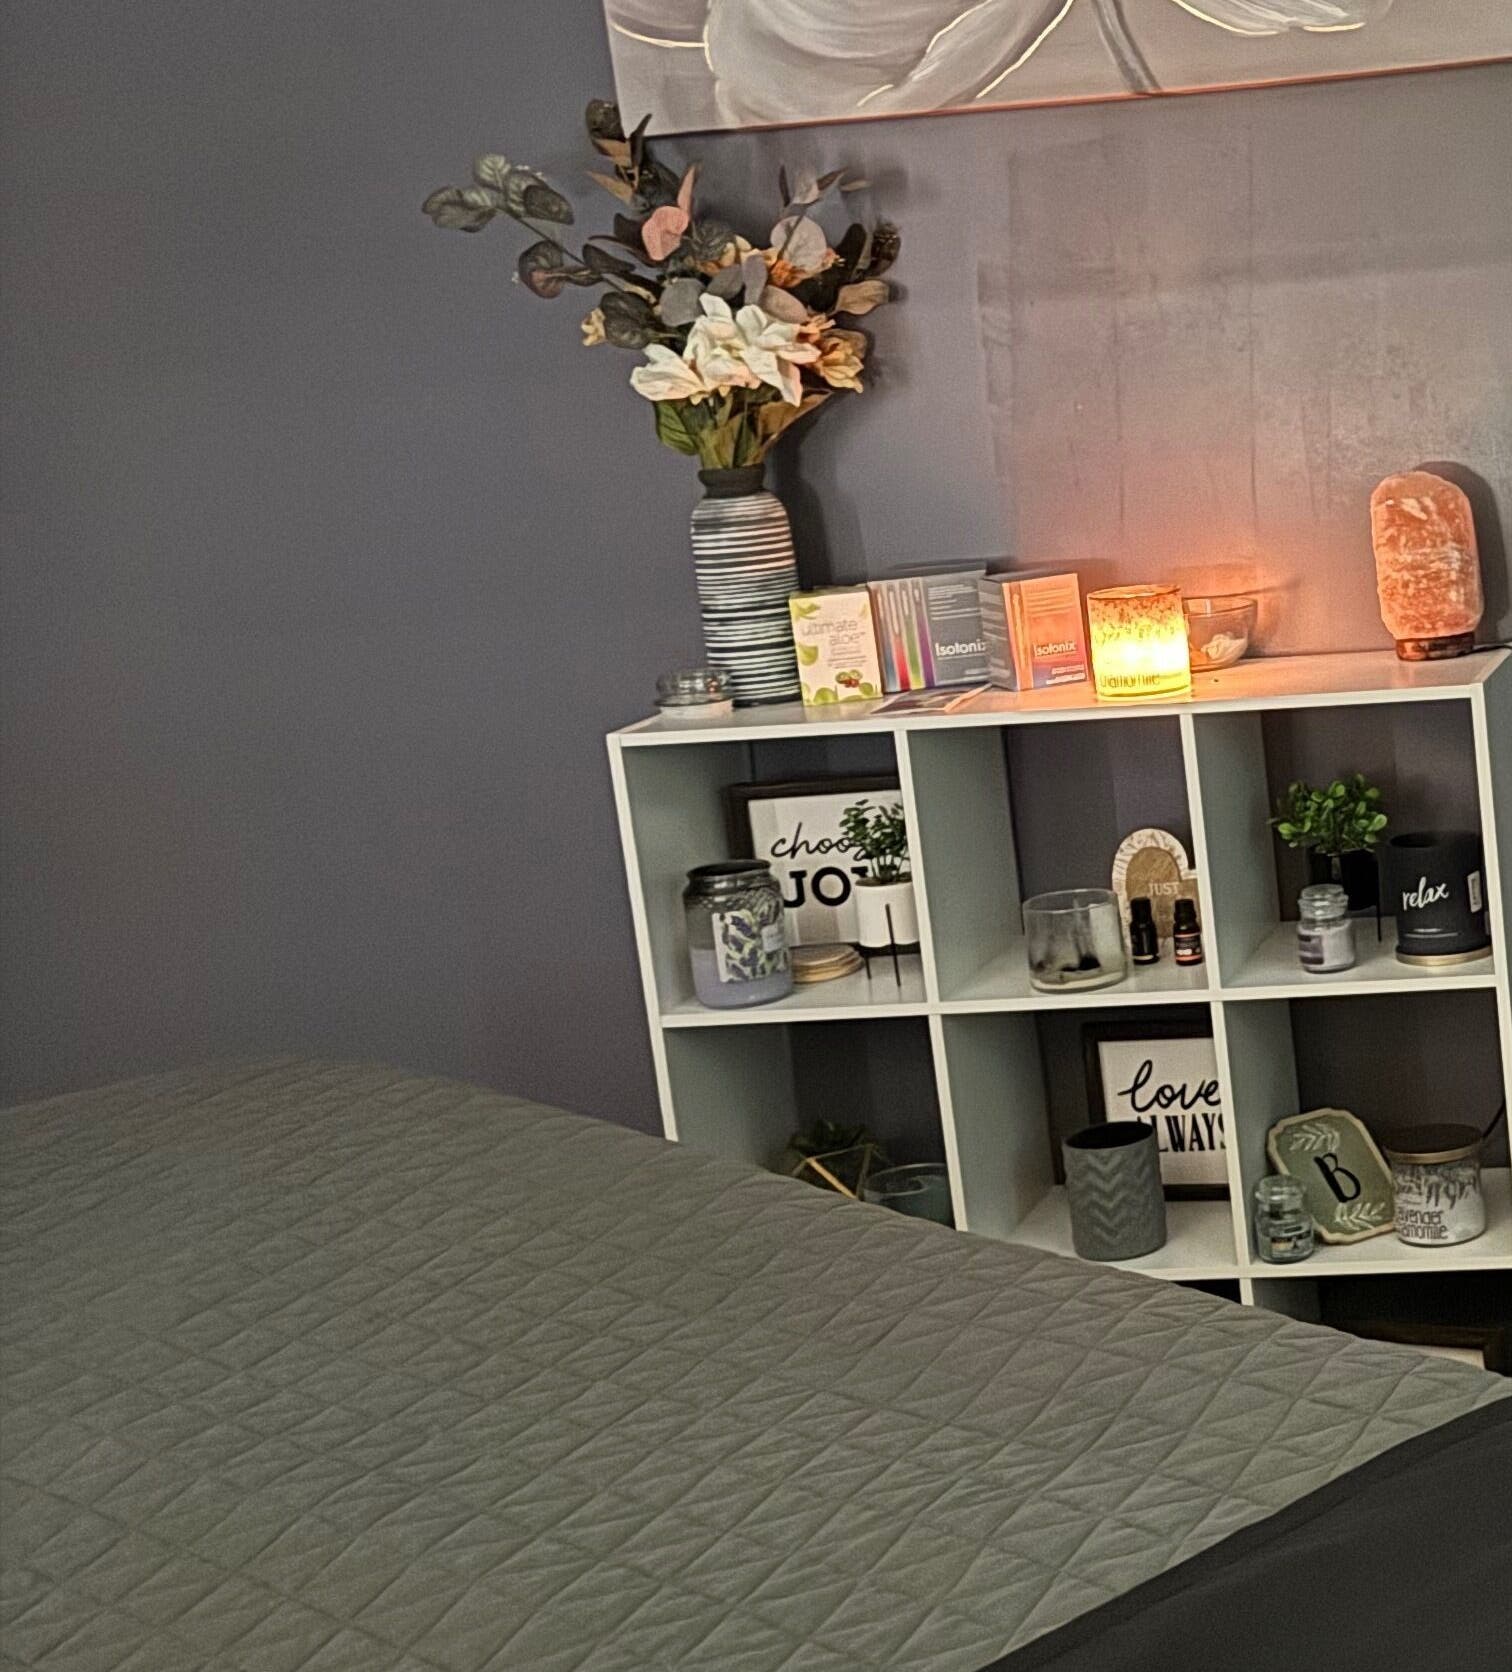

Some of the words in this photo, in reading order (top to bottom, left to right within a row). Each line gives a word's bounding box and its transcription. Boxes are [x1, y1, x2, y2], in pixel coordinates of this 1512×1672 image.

[1033, 642, 1077, 657] Isotonix
[771, 822, 874, 861] choo
[783, 866, 869, 908] JO
[1148, 882, 1179, 896] JUST
[1402, 876, 1449, 911] relax
[1117, 1059, 1222, 1113] love
[1137, 1112, 1226, 1152] LWAYS
[1314, 1152, 1361, 1203] B
